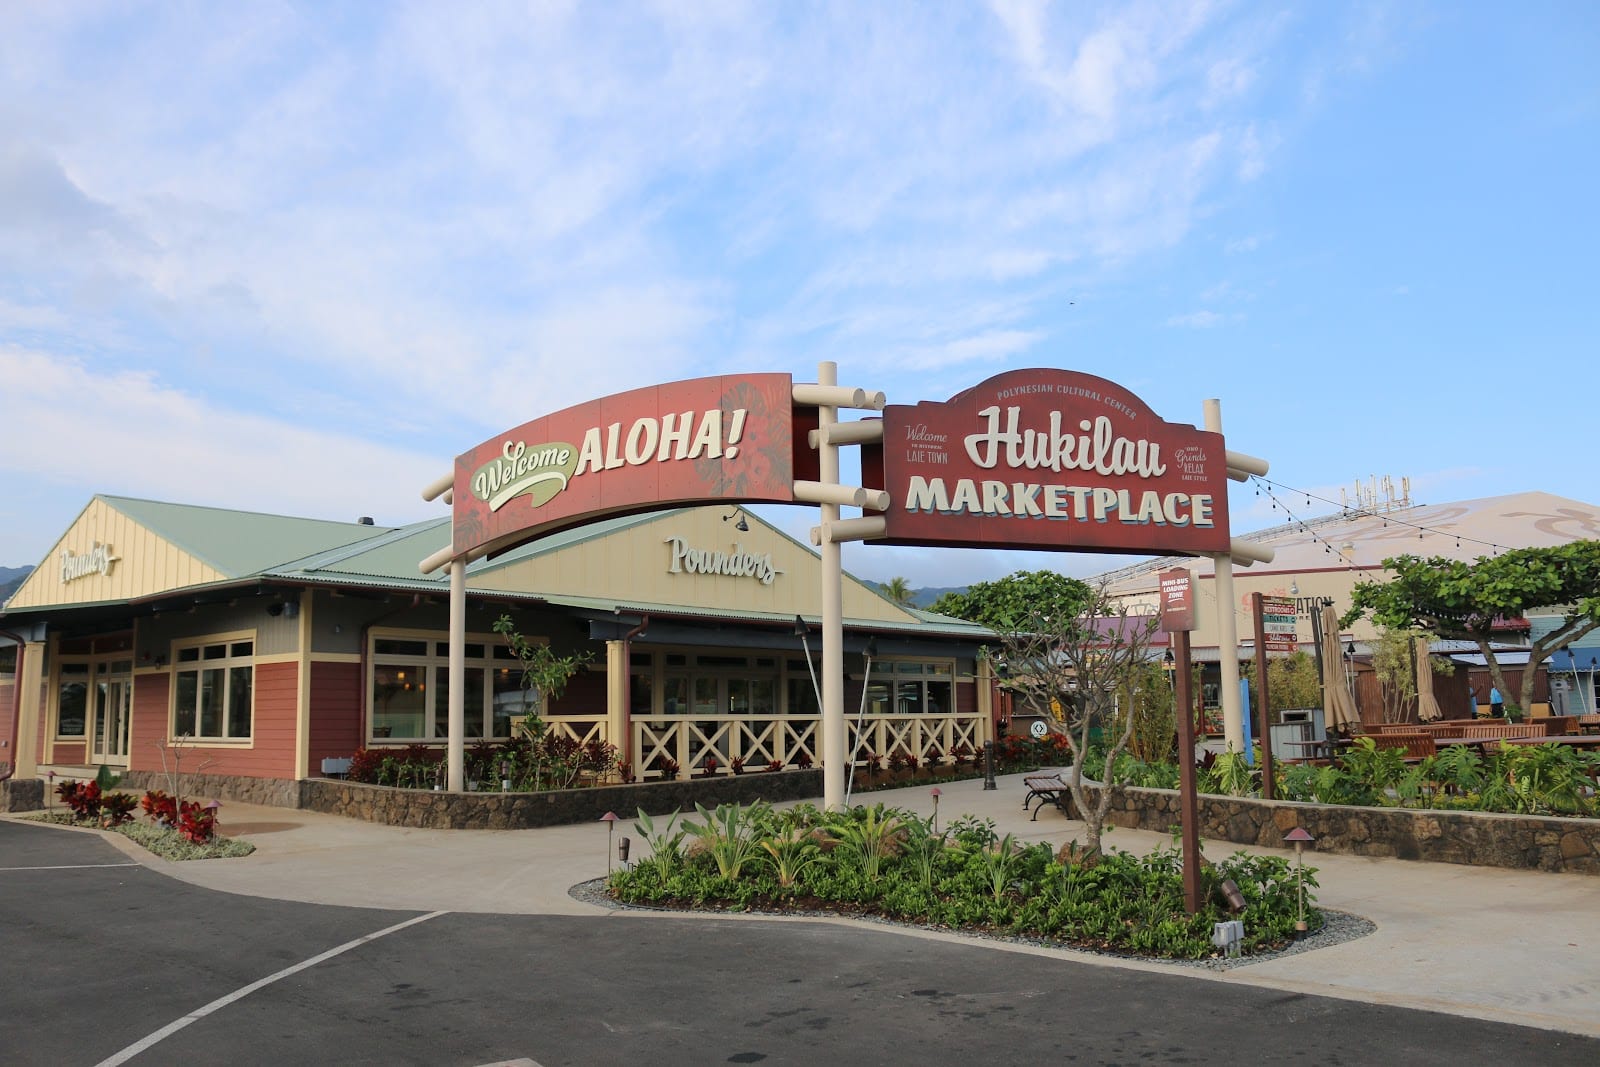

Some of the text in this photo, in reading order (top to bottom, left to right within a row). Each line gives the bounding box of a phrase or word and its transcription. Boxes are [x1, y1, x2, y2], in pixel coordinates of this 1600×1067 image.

[997, 384, 1137, 420] POLYNESIAN CULTURAL CENTER
[575, 408, 748, 476] ALOHA!
[904, 423, 948, 442] Welcome
[963, 405, 1166, 479] Hukilau
[906, 449, 948, 464] LAIE TOWN
[1175, 447, 1207, 469] Grinds
[475, 440, 570, 500] Welcome
[1183, 463, 1204, 474] RELAX
[904, 475, 1215, 529] MARKETPLACE
[663, 535, 784, 585] Pounders
[1163, 584, 1189, 593] LOADING
[1168, 591, 1184, 599] ZONE
[1296, 596, 1332, 614] ATION
